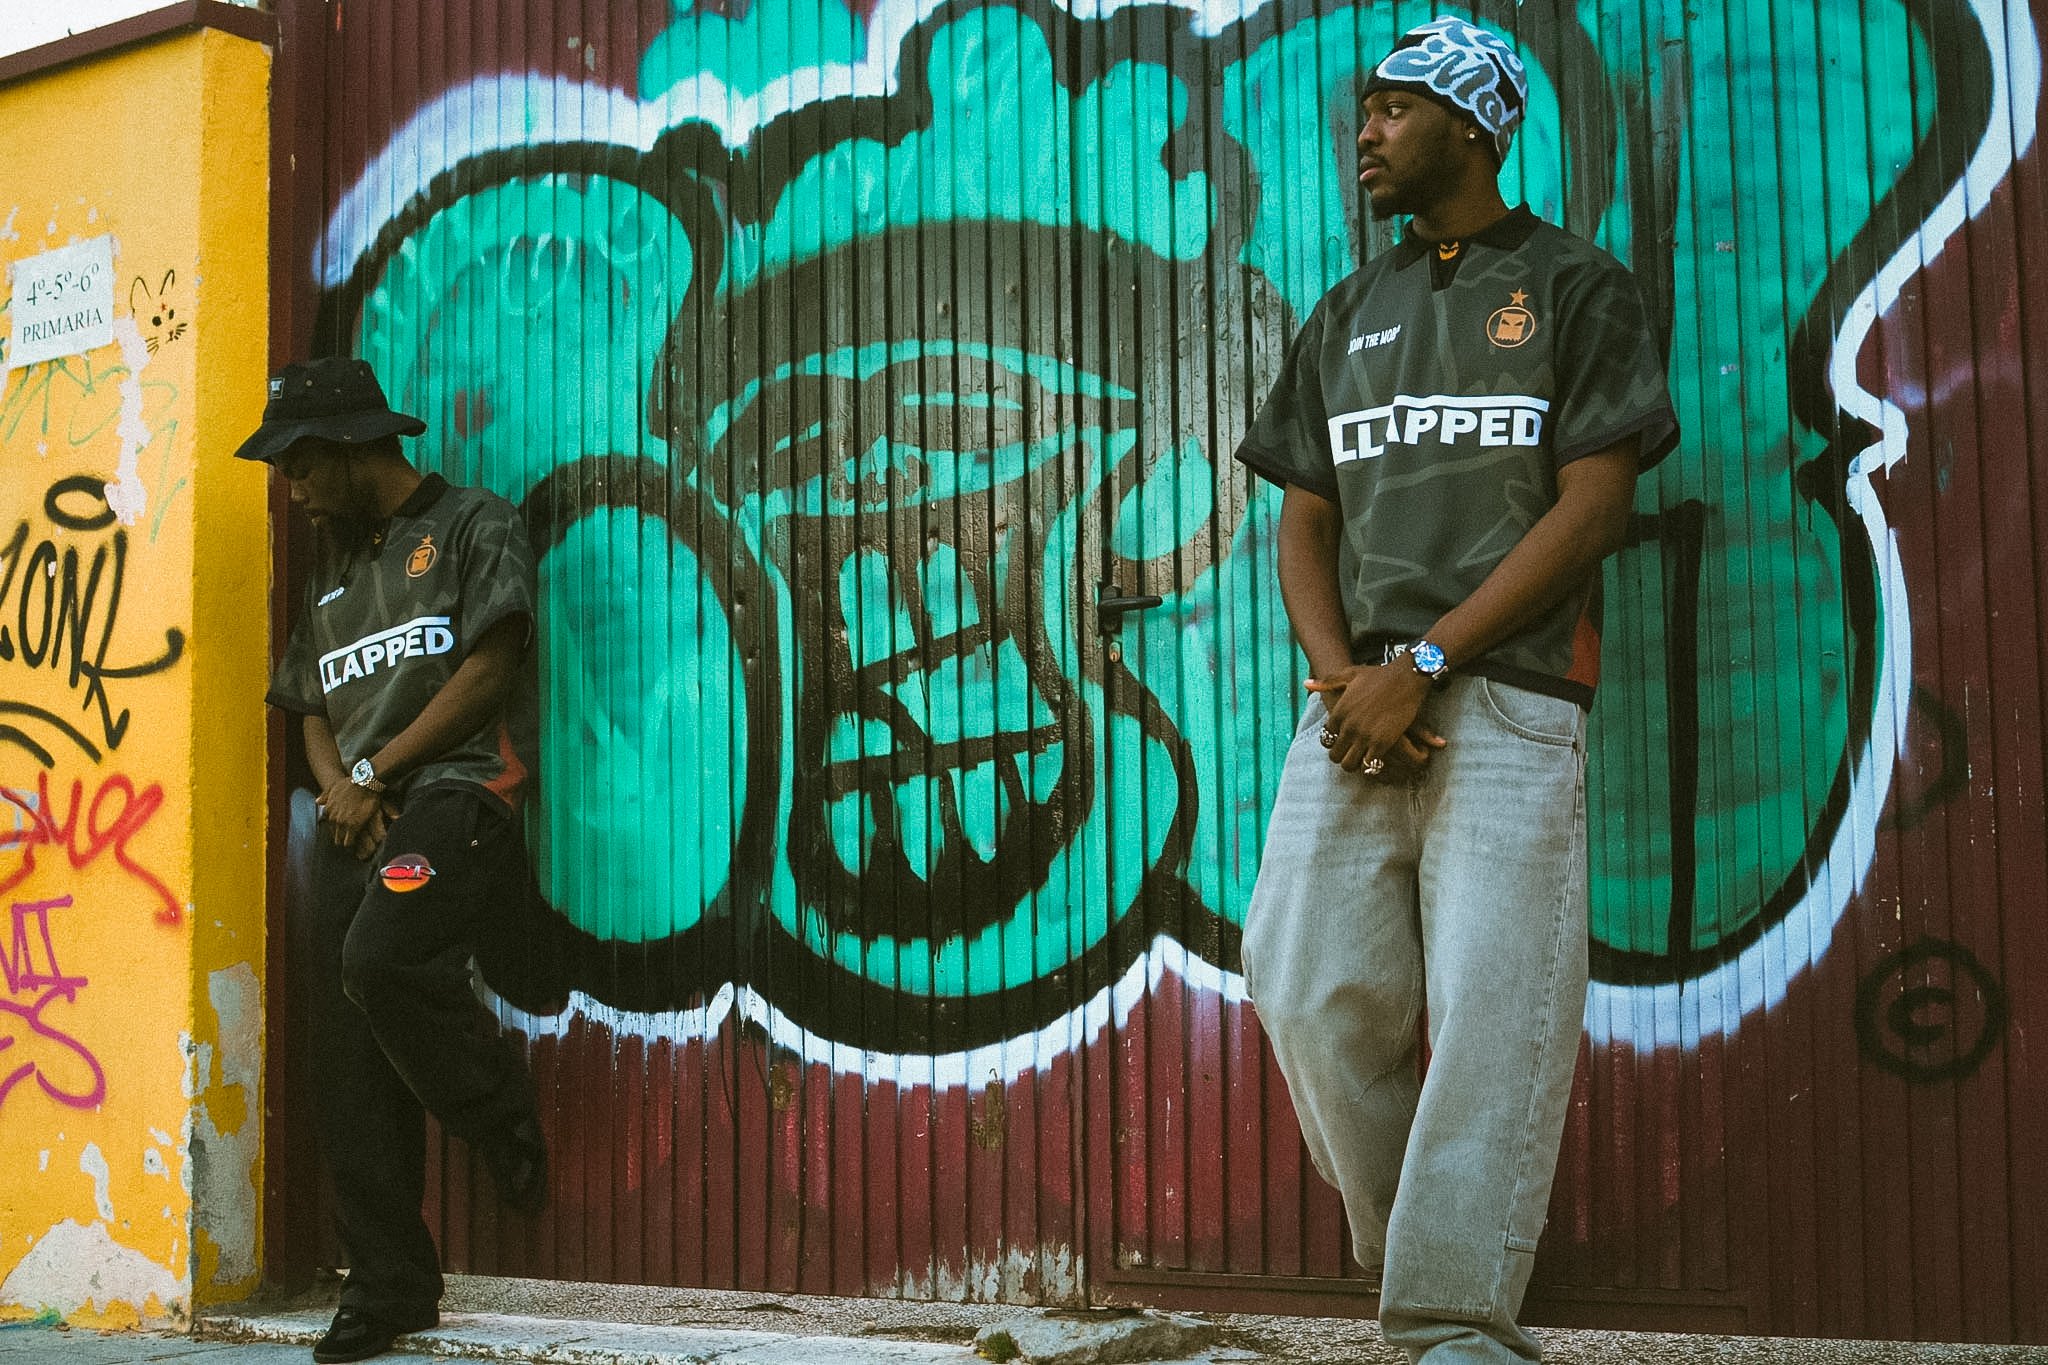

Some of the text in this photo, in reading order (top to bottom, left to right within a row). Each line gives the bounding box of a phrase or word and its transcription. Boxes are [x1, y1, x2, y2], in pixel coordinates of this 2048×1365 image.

[23, 308, 103, 344] PRIMARIA
[1365, 332, 1380, 348] THE
[1328, 395, 1549, 466] CLAPPED
